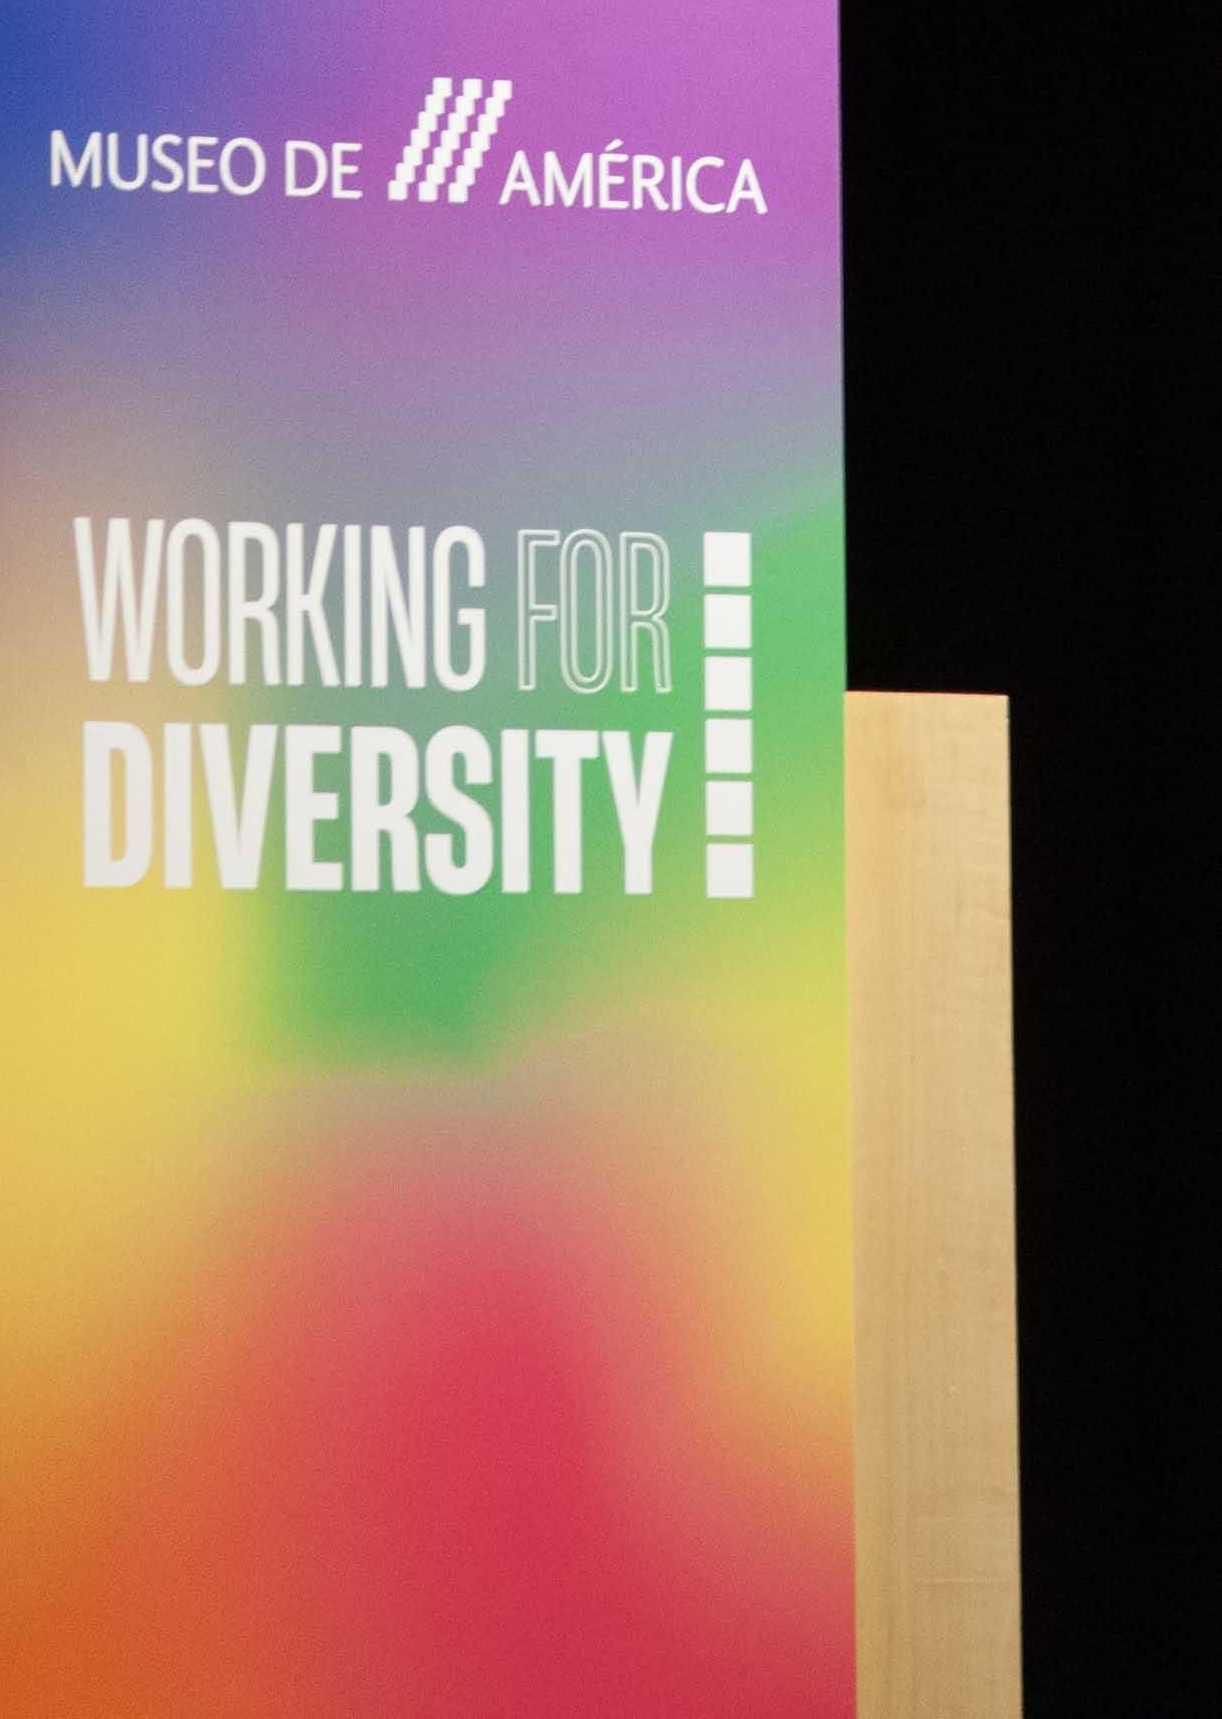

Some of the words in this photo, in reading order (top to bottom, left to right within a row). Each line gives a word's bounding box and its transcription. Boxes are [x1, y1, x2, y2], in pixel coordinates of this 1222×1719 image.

[49, 129, 266, 197] MUSEO
[284, 140, 363, 200] DE
[498, 138, 769, 215] AMÉRICA
[73, 516, 487, 692] WORKING
[516, 528, 673, 694] FOR
[82, 719, 675, 897] DIVERSITY
